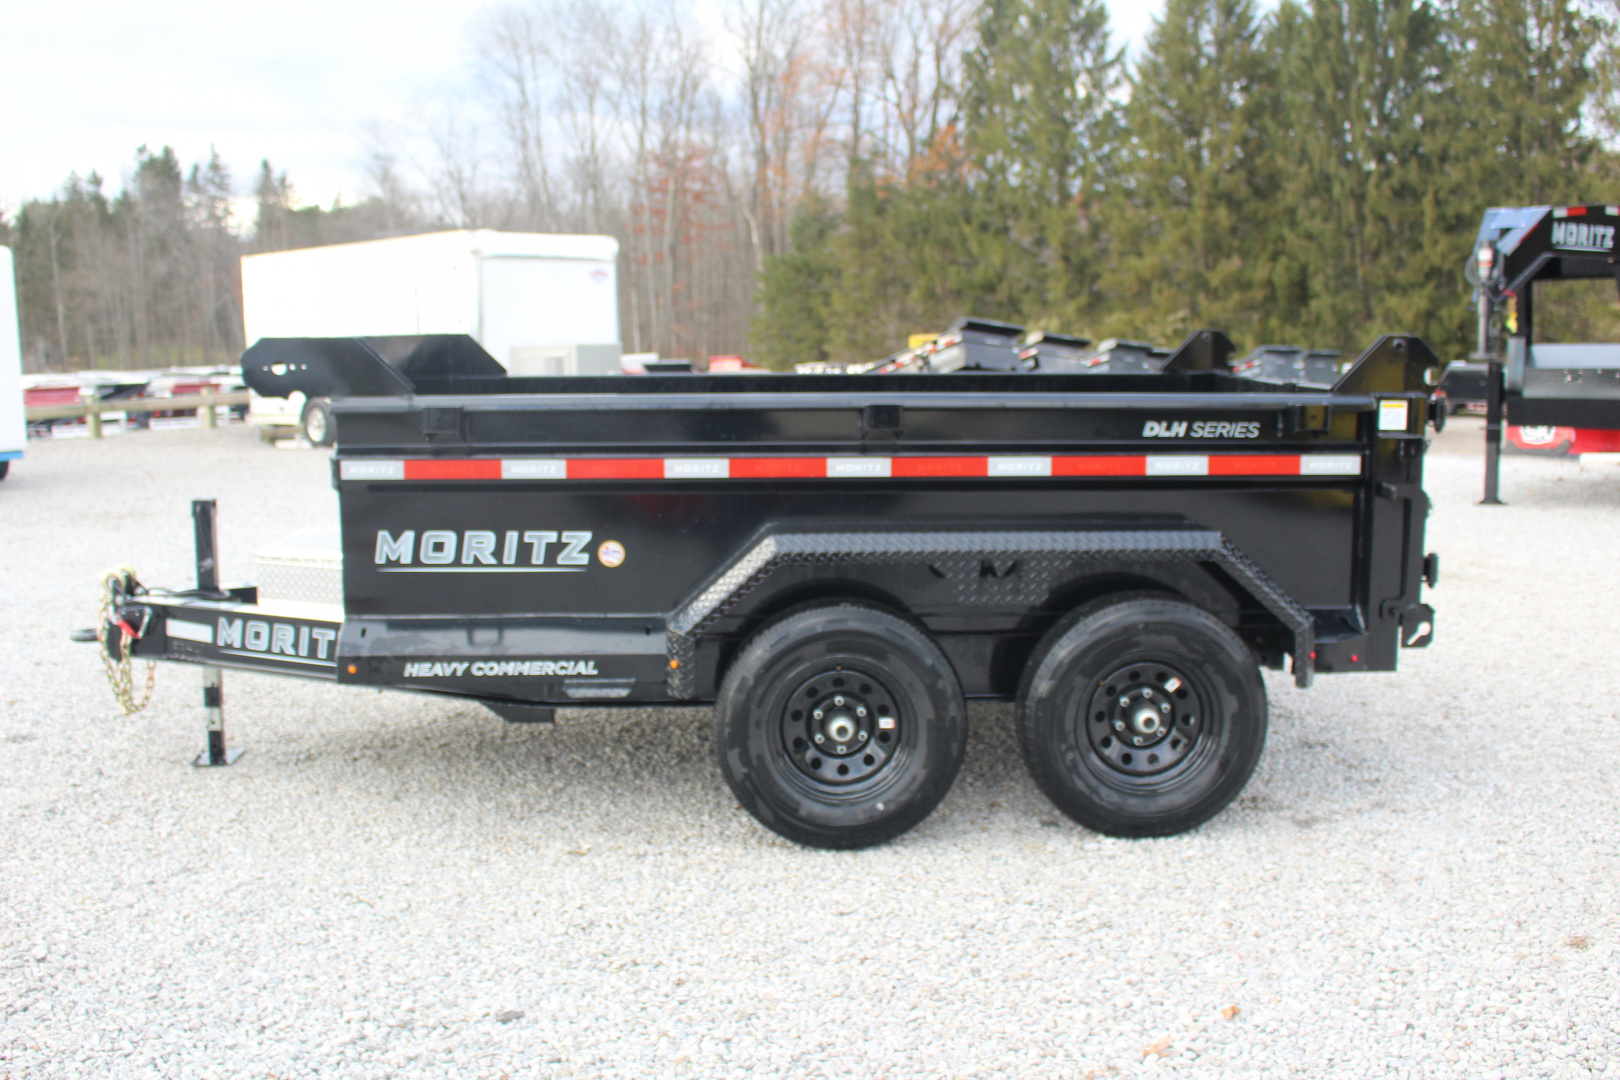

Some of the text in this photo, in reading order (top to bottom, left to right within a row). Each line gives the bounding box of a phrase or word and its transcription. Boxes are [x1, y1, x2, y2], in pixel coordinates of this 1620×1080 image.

[1551, 221, 1616, 249] MORITZ
[1142, 420, 1261, 438] DLH SERIES
[349, 466, 395, 475] MORITZ
[510, 465, 557, 474] MORITZ
[673, 464, 719, 473] MORITZ
[836, 463, 882, 472] MORITZ
[996, 463, 1042, 472] MORITZ
[1154, 462, 1199, 471] MORITZ
[1309, 462, 1353, 471] MORITZ
[374, 530, 592, 566] MORITZ
[216, 616, 337, 660] MORIT
[403, 661, 599, 678] HEAVY COMMERCIAL
